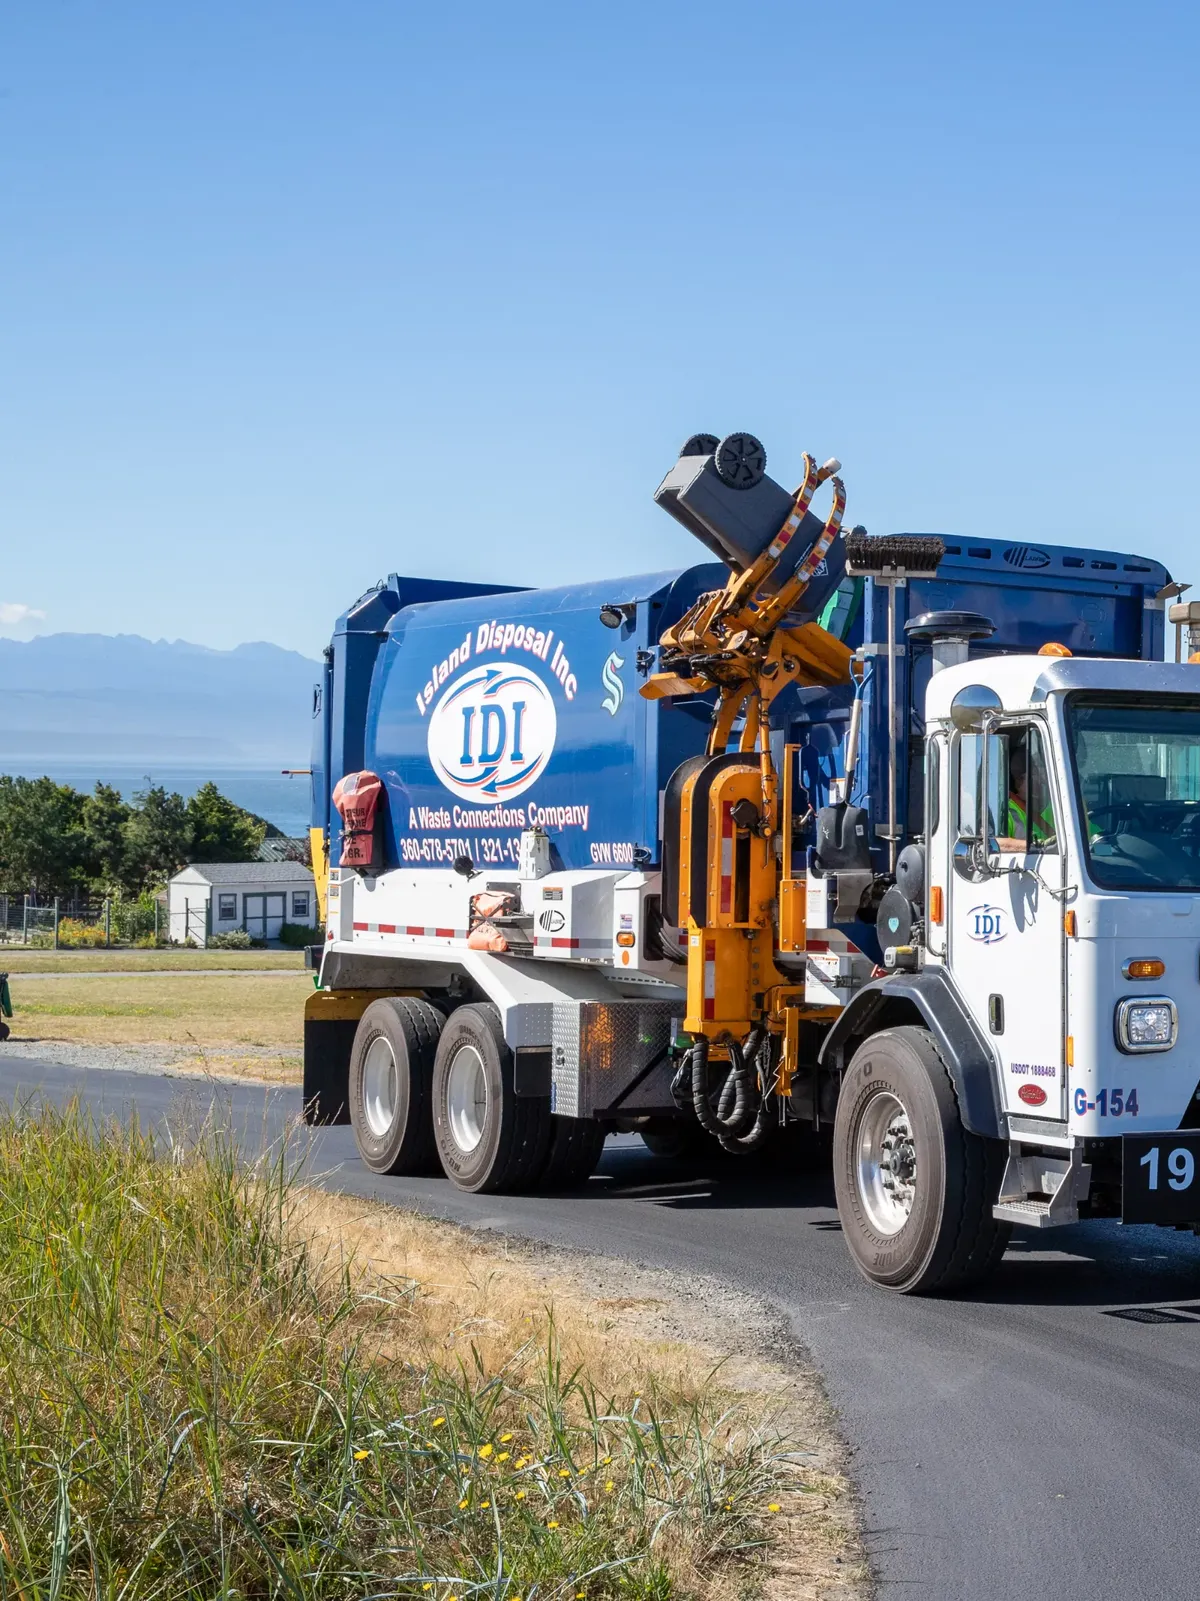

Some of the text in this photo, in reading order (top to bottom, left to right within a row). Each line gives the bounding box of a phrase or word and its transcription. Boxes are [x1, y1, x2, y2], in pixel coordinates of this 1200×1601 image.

[416, 620, 578, 717] Island Disposal Inc
[460, 701, 527, 767] IDI
[409, 801, 588, 832] A Waste Connections Company
[400, 837, 473, 862] 360-678-5701
[481, 837, 522, 863] 321-13
[590, 842, 612, 864] GVW
[974, 915, 1002, 936] IDI
[1011, 1062, 1030, 1075] USDOT
[1074, 1087, 1139, 1117] G-154
[1140, 1147, 1195, 1191] 19
